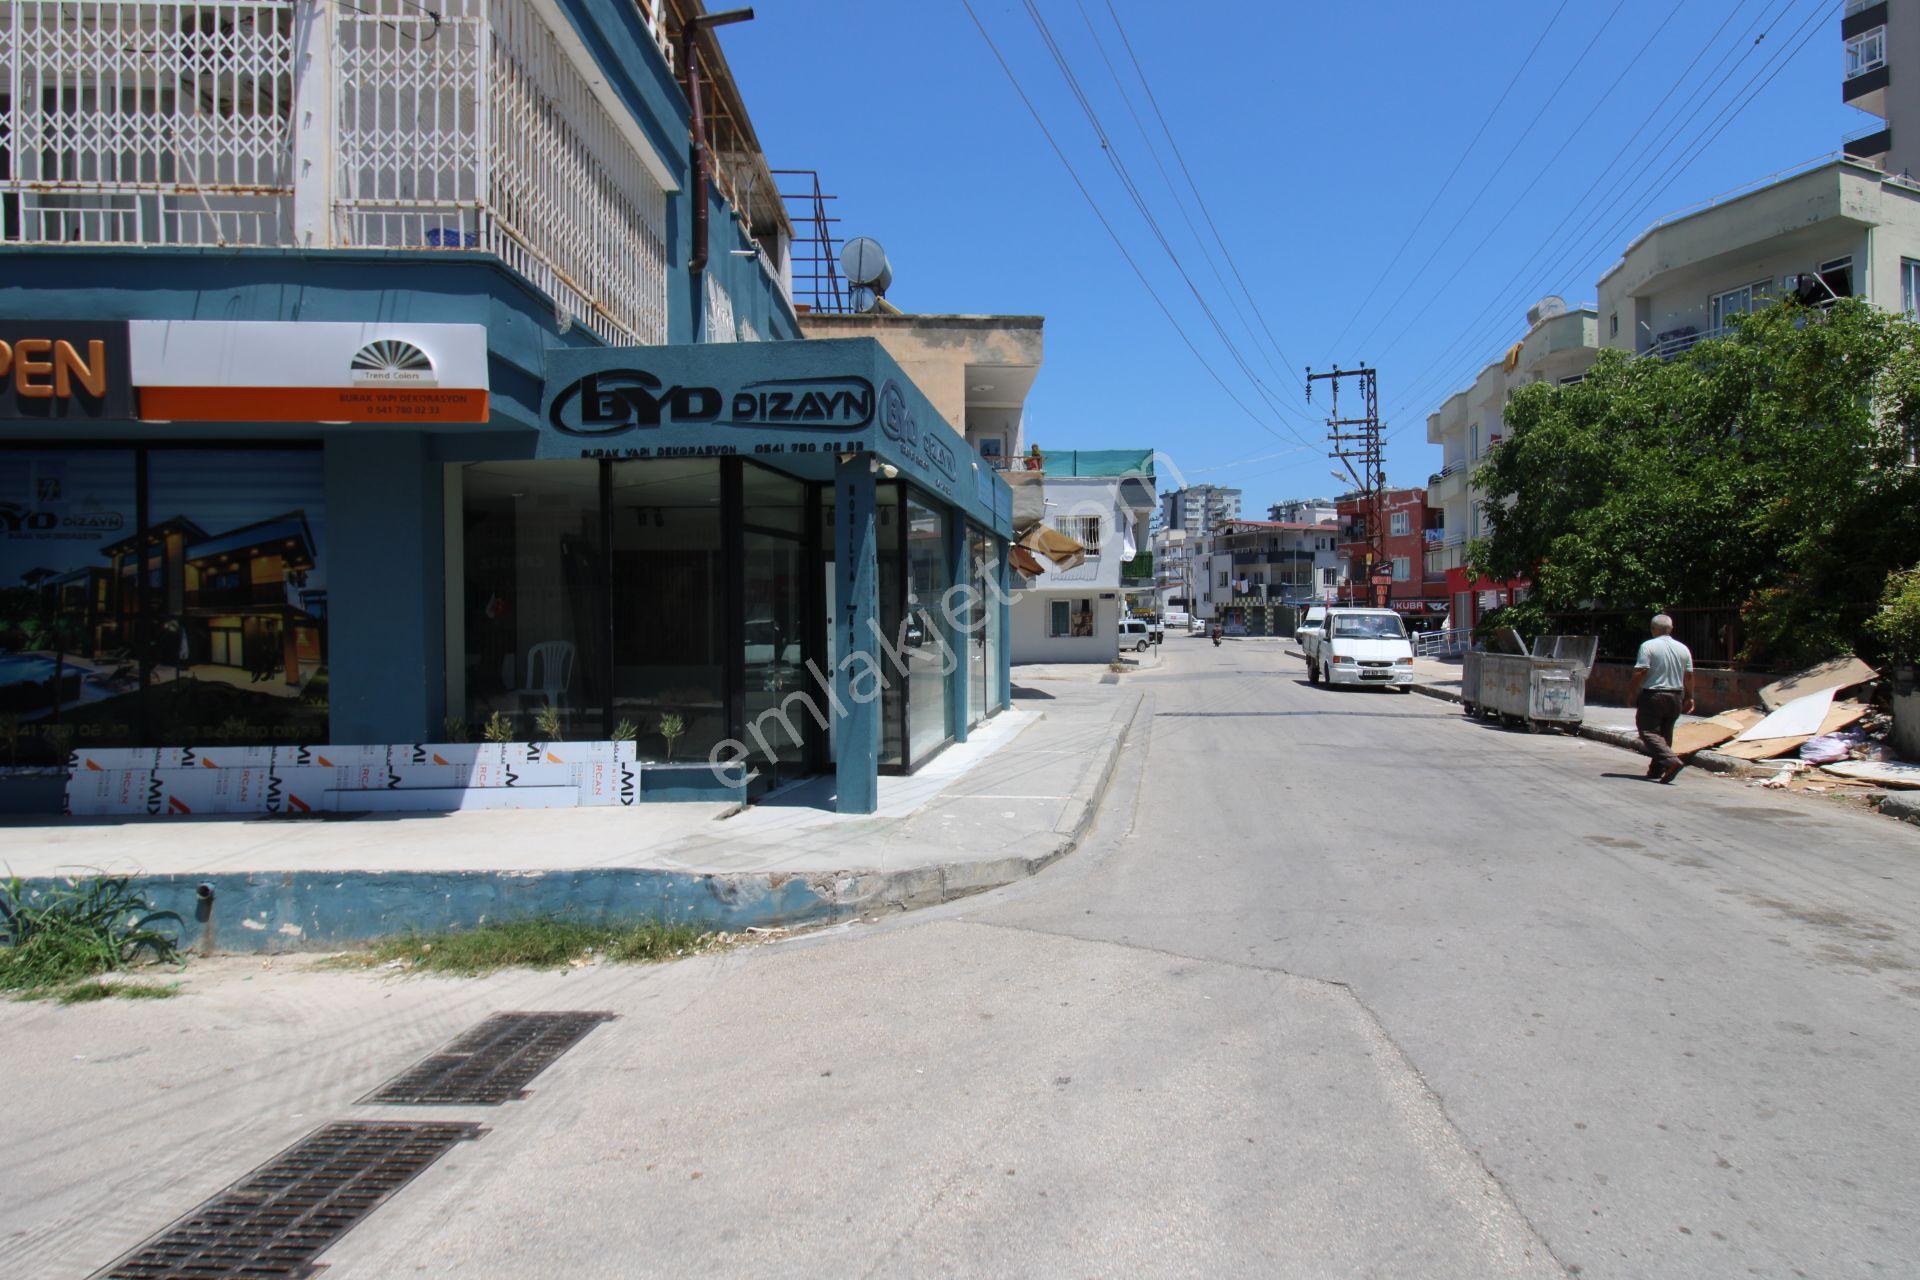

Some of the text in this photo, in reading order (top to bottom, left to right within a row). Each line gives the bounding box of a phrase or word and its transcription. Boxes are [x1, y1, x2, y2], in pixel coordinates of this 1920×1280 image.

[365, 371, 420, 380] Trend Colors
[340, 394, 372, 403] BURAK
[399, 394, 468, 403] DEKORASYON
[732, 391, 869, 422] DIZAYN
